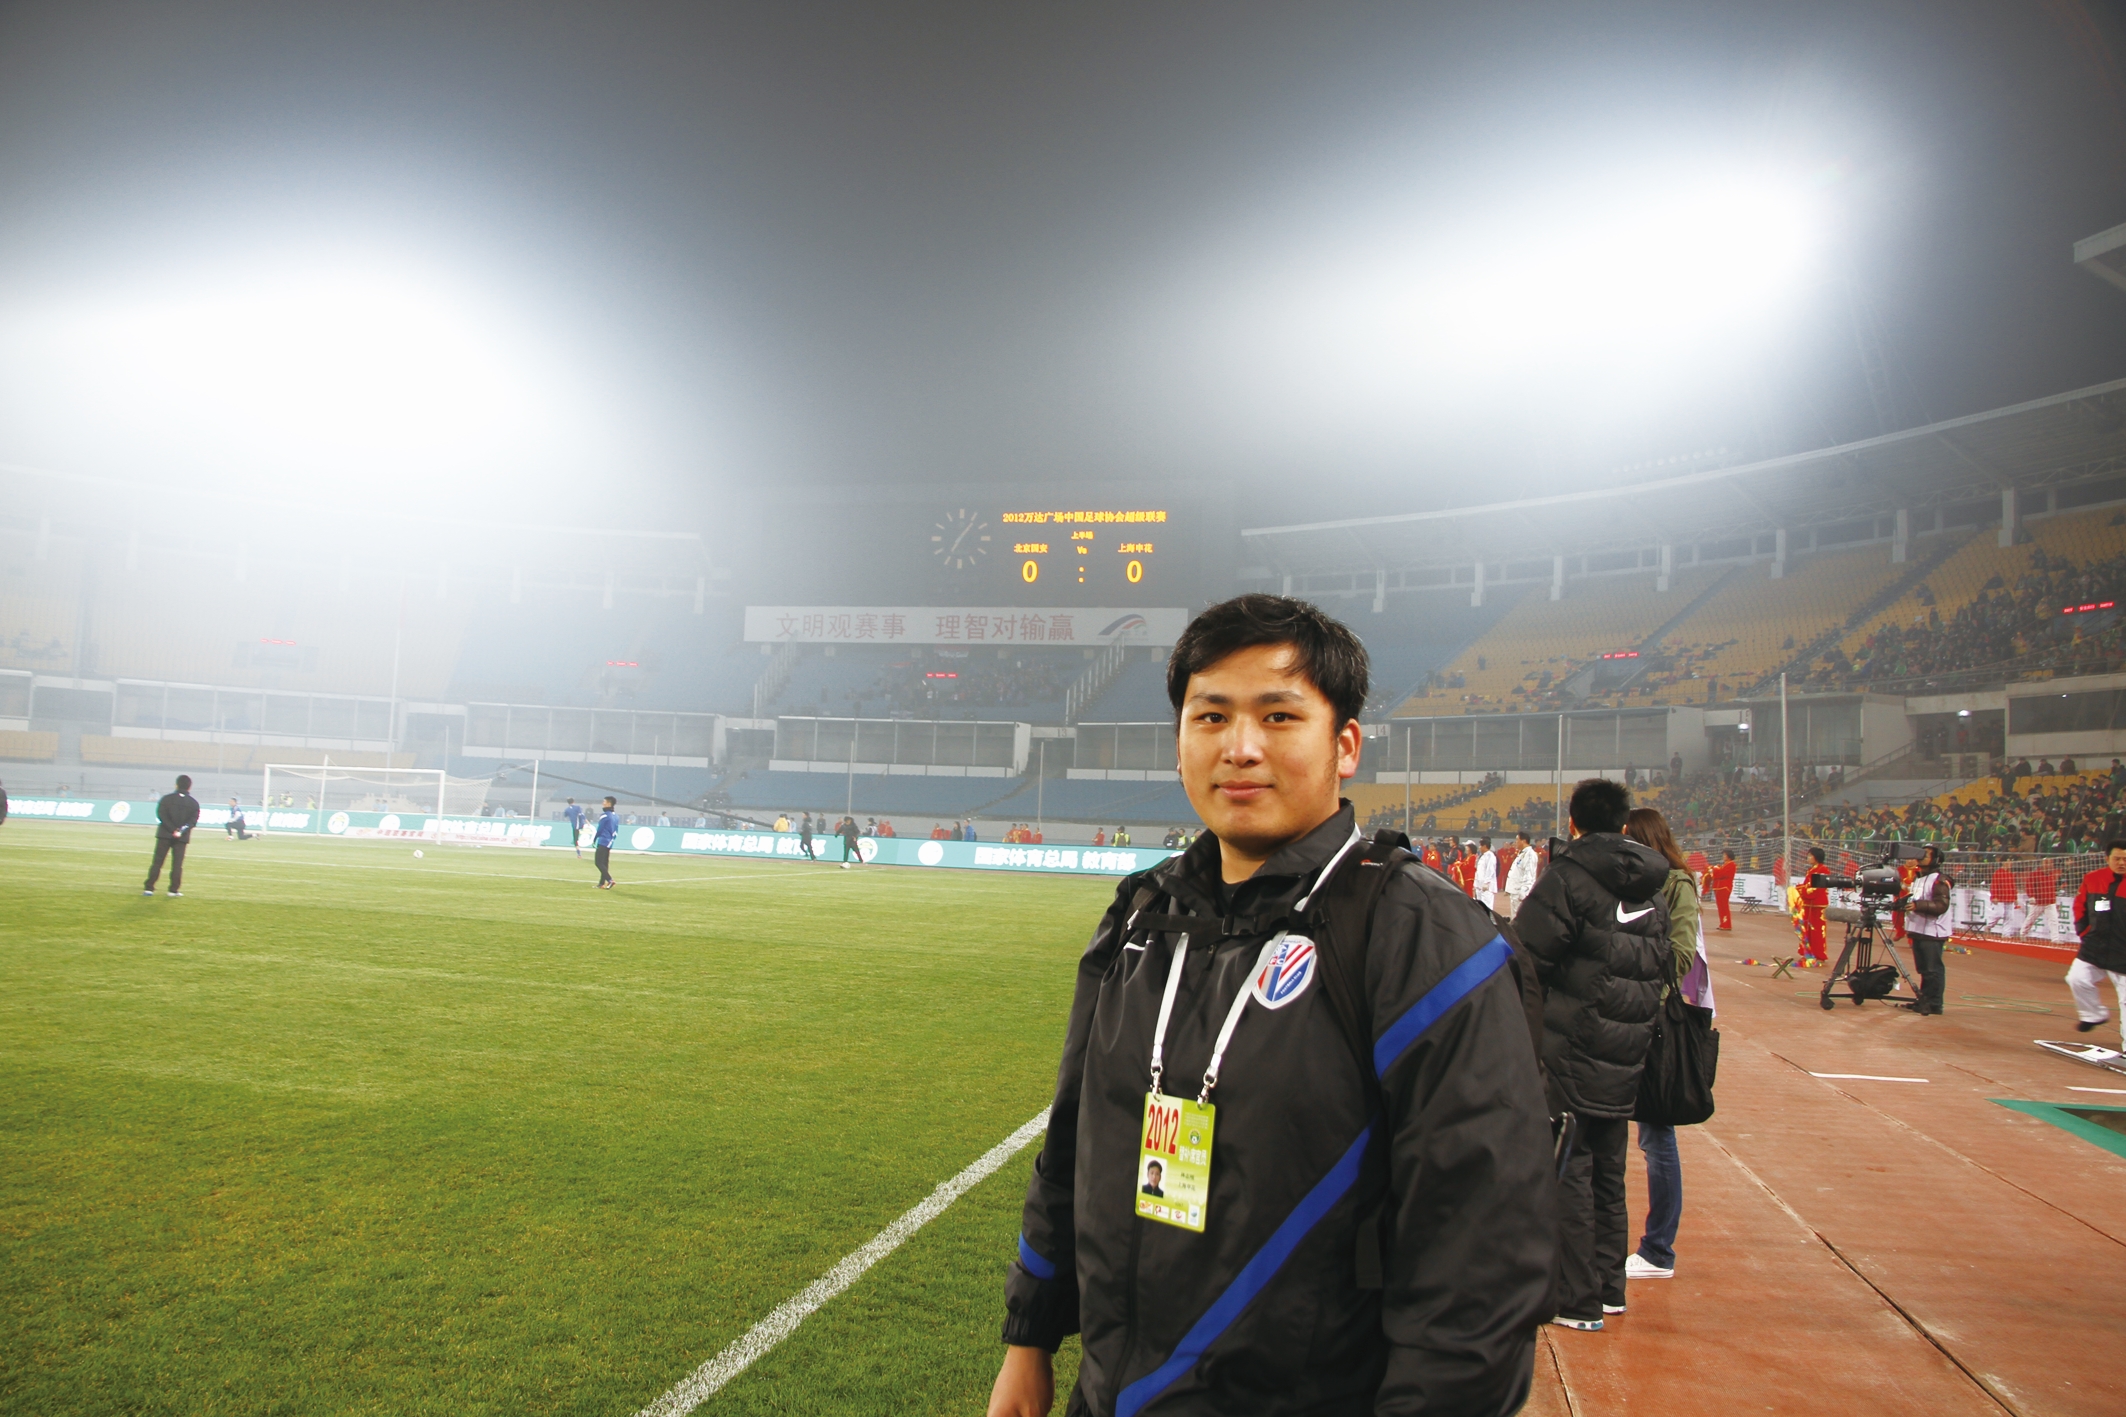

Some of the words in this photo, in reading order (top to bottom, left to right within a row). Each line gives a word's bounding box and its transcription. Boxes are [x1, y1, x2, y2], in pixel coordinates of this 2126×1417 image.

[1002, 510, 1167, 524] 2012万达广场中国足球协会超级联赛
[1013, 543, 1049, 554] 北京国安
[1118, 543, 1154, 554] 上海申花
[1022, 560, 1039, 583] 0
[1126, 560, 1143, 583] 0
[776, 612, 906, 639] 文明观赛事
[935, 613, 1075, 641] 理智对输赢
[974, 846, 1079, 869] 国家体育总局
[1081, 850, 1137, 871] 教育部
[1144, 1103, 1180, 1155] 2012
